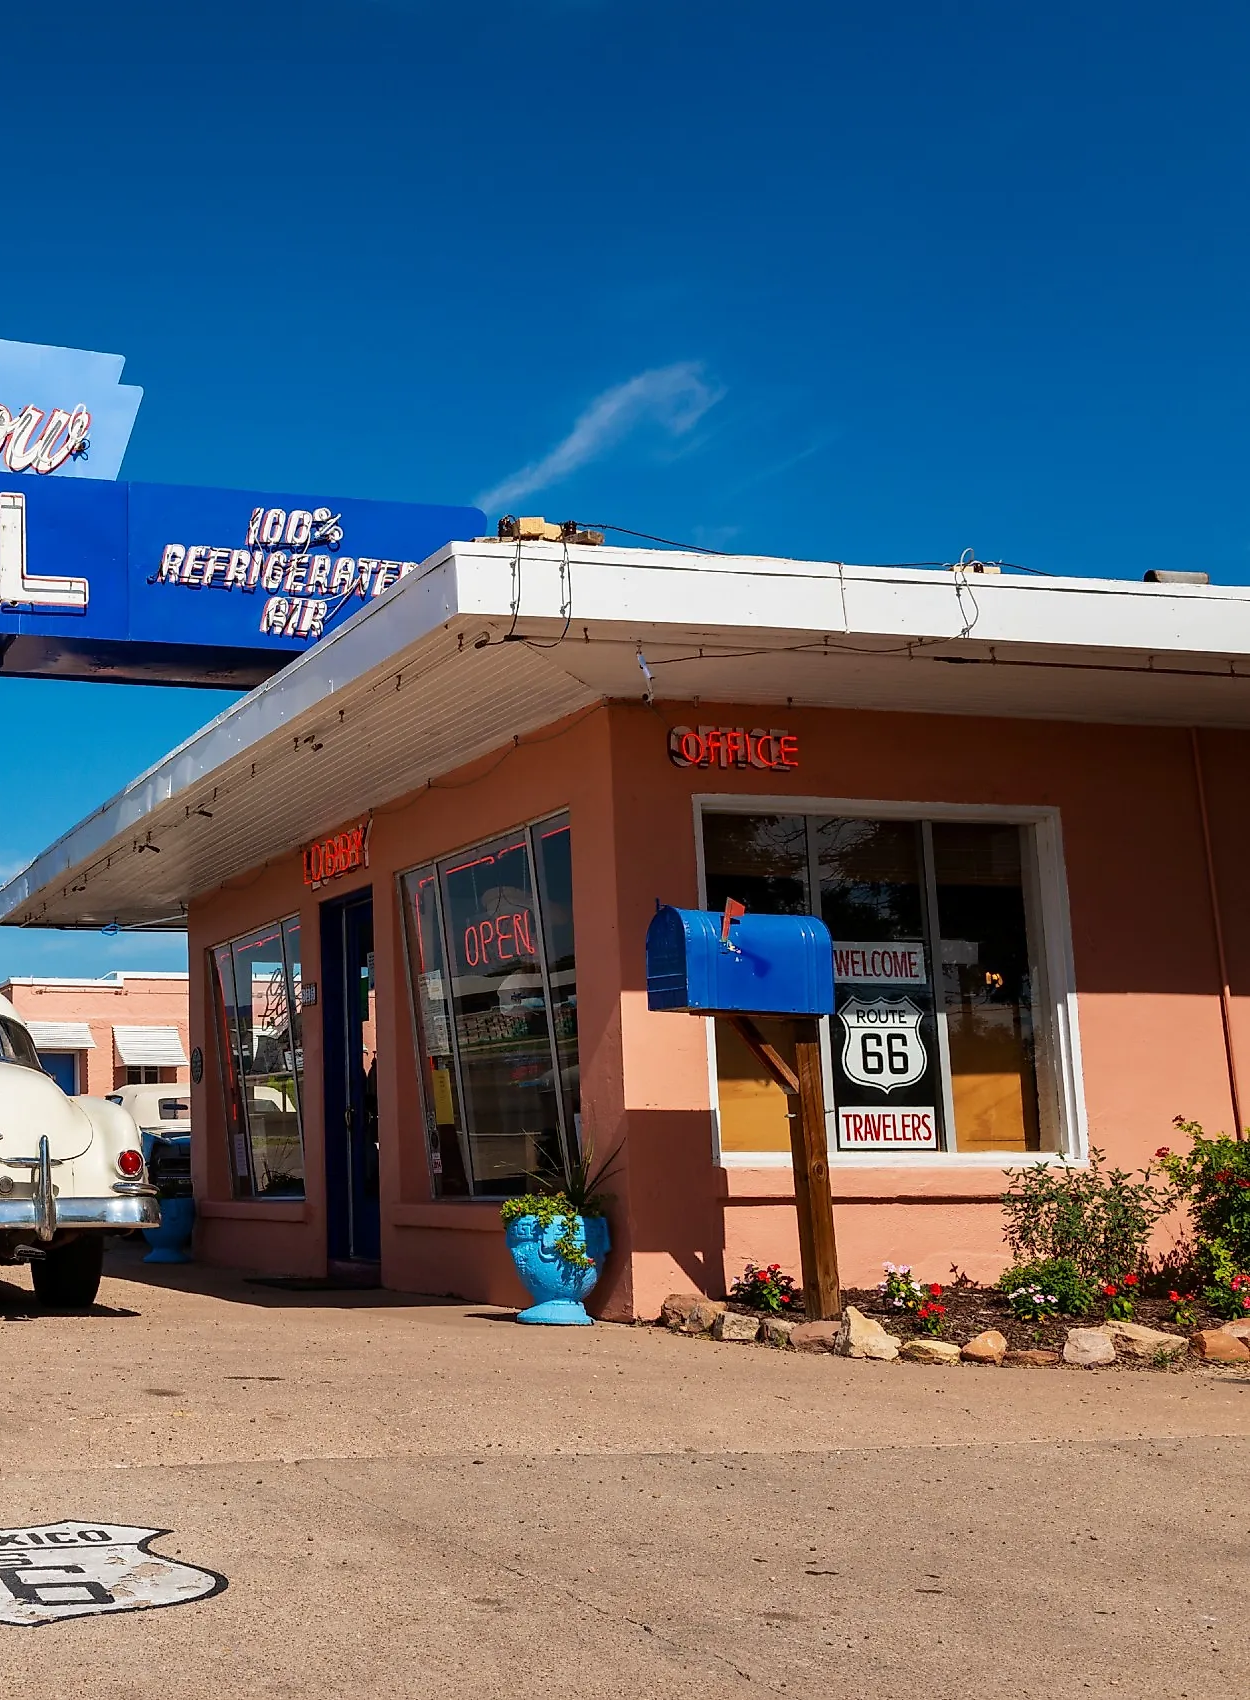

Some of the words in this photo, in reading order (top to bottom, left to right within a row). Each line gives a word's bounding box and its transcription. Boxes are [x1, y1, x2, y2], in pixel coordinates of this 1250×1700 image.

[247, 506, 344, 552] 100%
[259, 596, 329, 639] AIR
[668, 726, 800, 770] OFFICE
[303, 818, 374, 892] LOBBY
[464, 909, 536, 966] OPEN
[834, 950, 919, 980] WELCOME
[856, 1009, 907, 1025] ROUTE
[861, 1033, 909, 1075] 66
[841, 1113, 933, 1143] TRAVELERS
